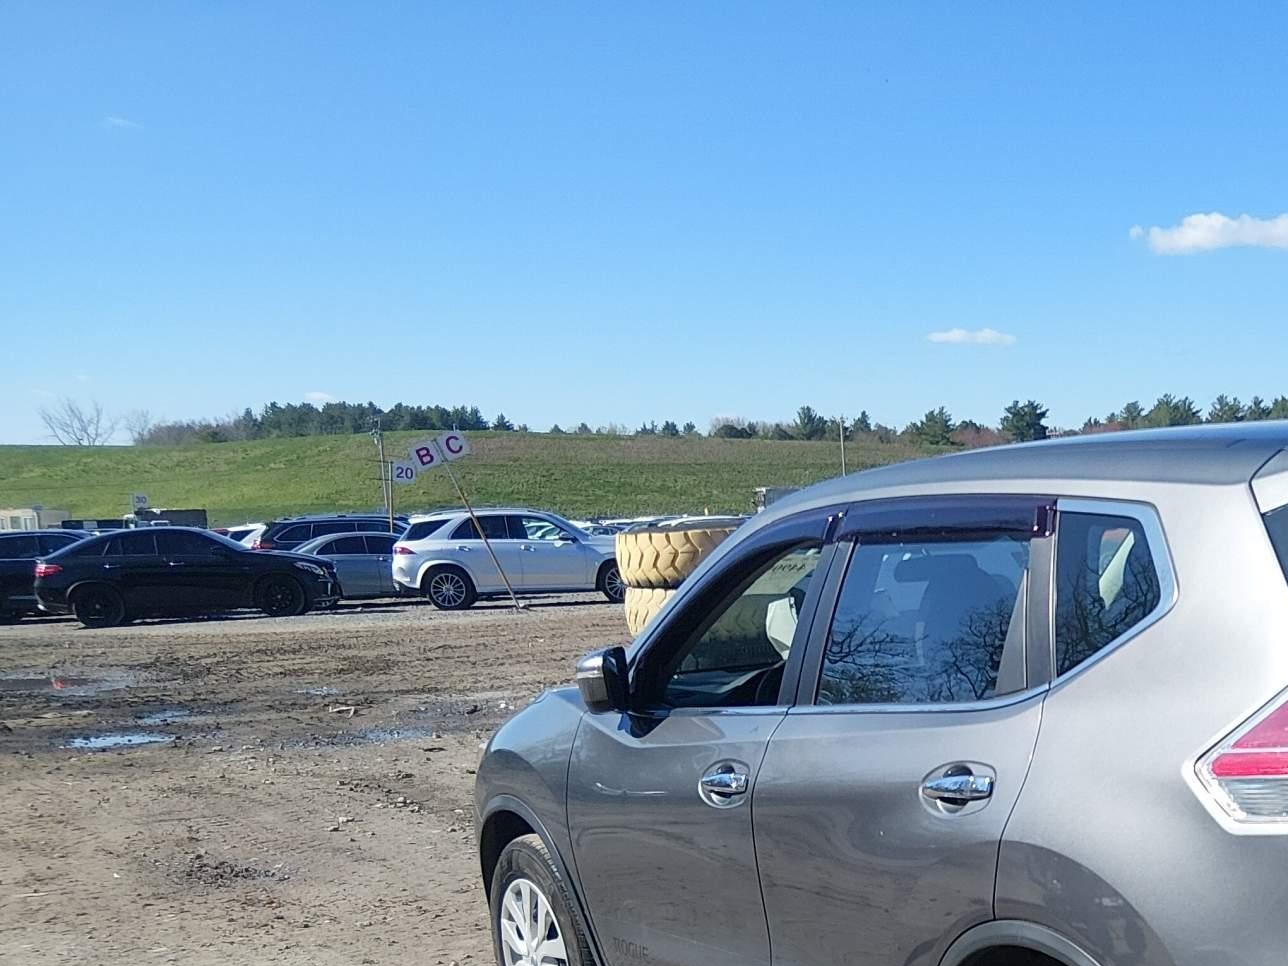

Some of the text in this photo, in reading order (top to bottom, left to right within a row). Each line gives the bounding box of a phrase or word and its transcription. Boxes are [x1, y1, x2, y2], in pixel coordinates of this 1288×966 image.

[445, 435, 463, 454] C
[415, 446, 435, 466] B
[395, 466, 414, 480] 20
